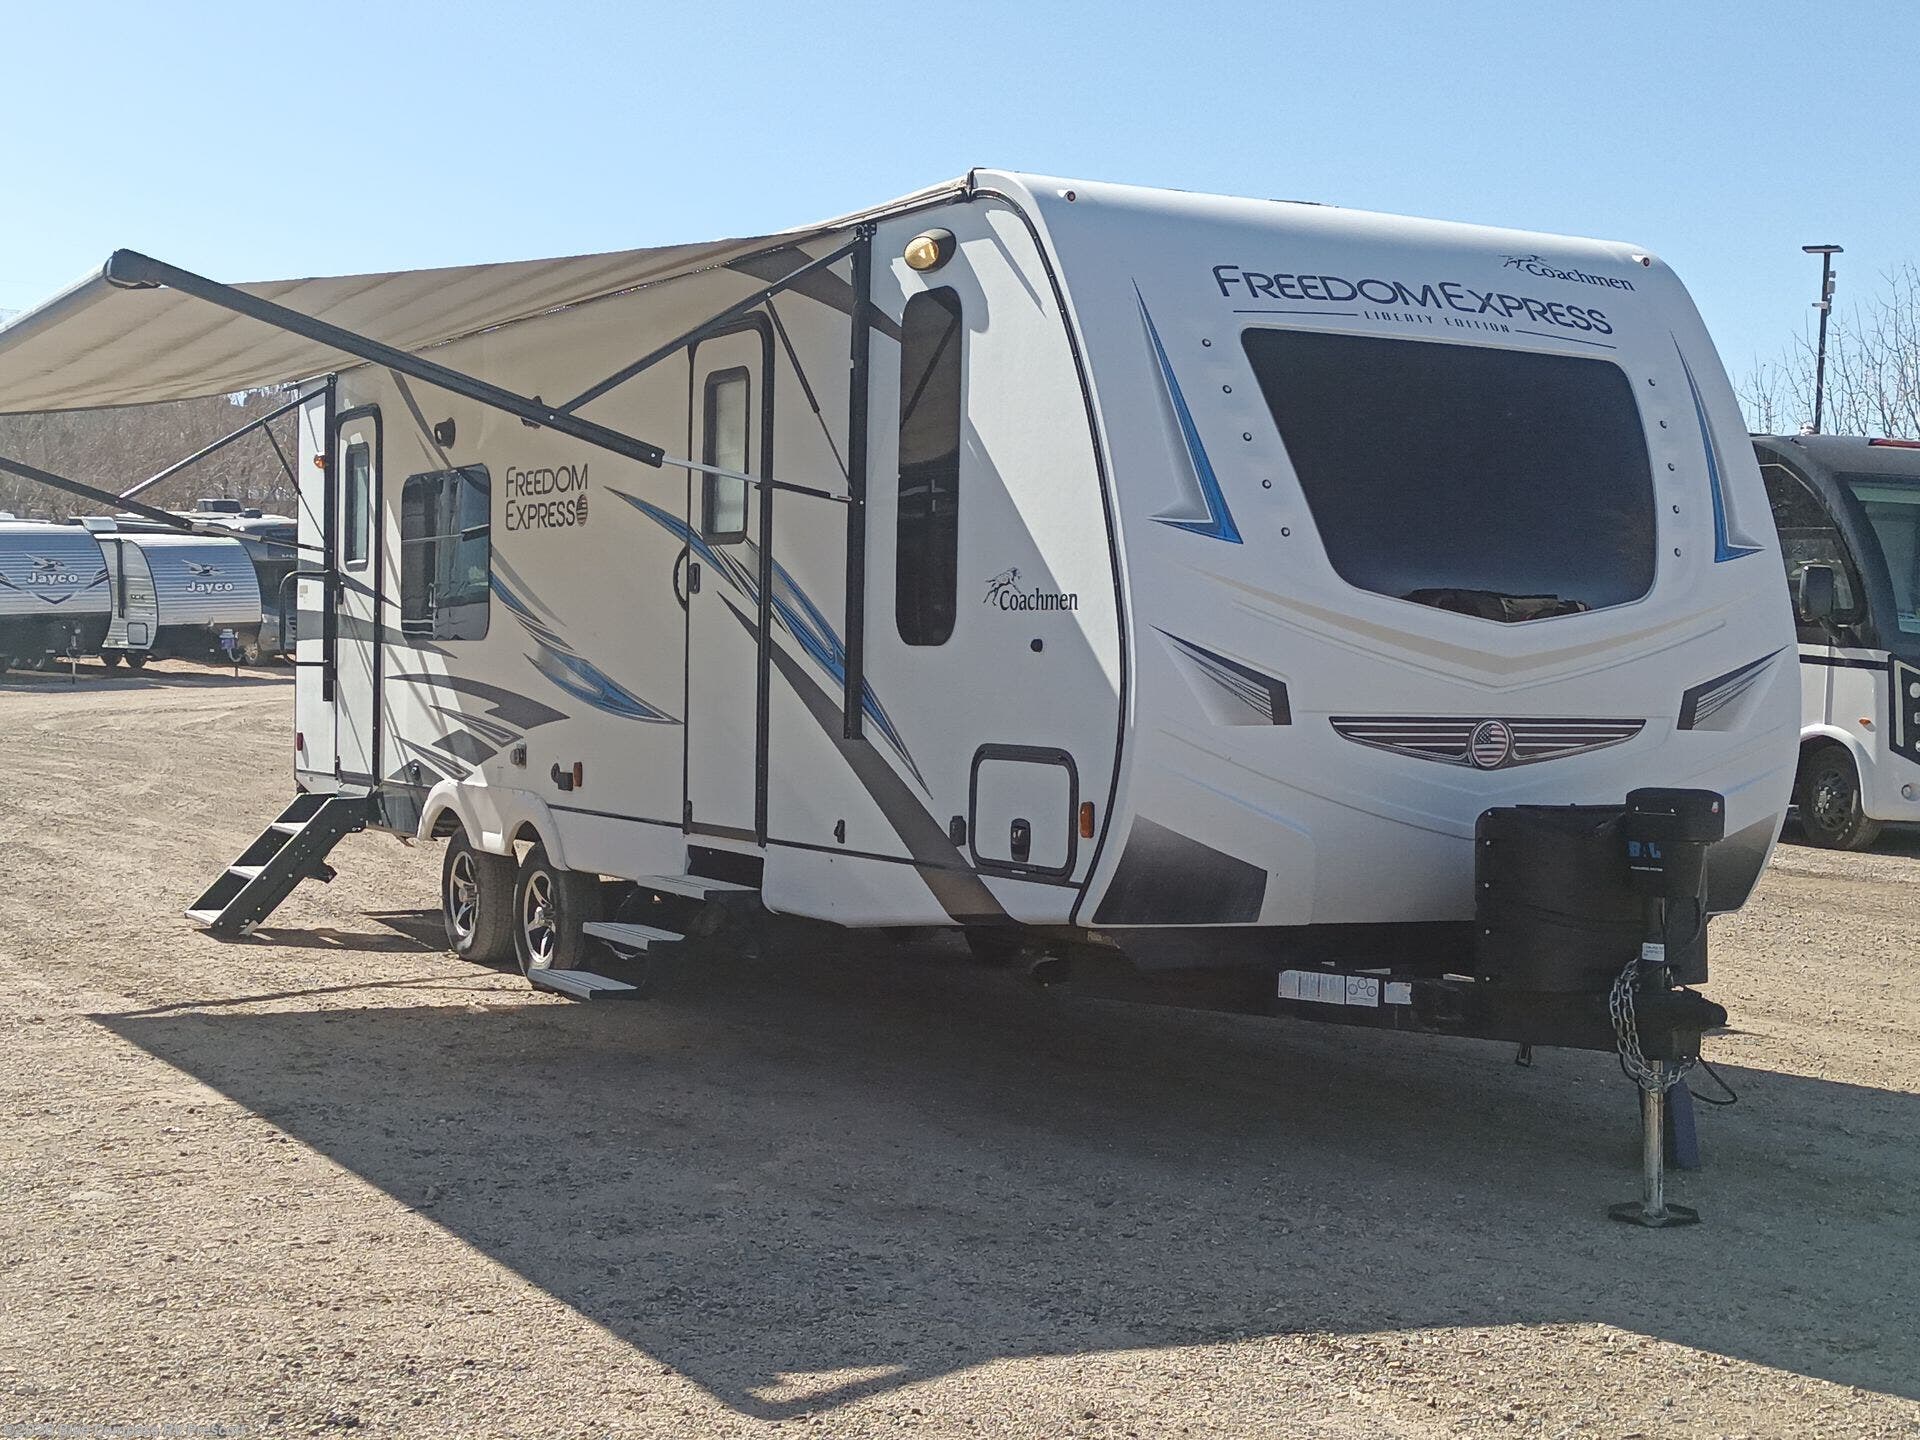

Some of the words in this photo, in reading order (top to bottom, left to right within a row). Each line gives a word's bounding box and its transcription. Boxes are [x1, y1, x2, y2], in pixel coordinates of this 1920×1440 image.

[1525, 263, 1635, 292] Coachmen
[1364, 310, 1433, 325] LIBERTY
[1444, 317, 1511, 333] EDITION
[505, 463, 588, 498] FREEDOM
[505, 500, 576, 531] EXPRESS
[27, 572, 79, 585] Jayco
[186, 581, 234, 594] Jayco
[1000, 587, 1079, 611] Coachmen
